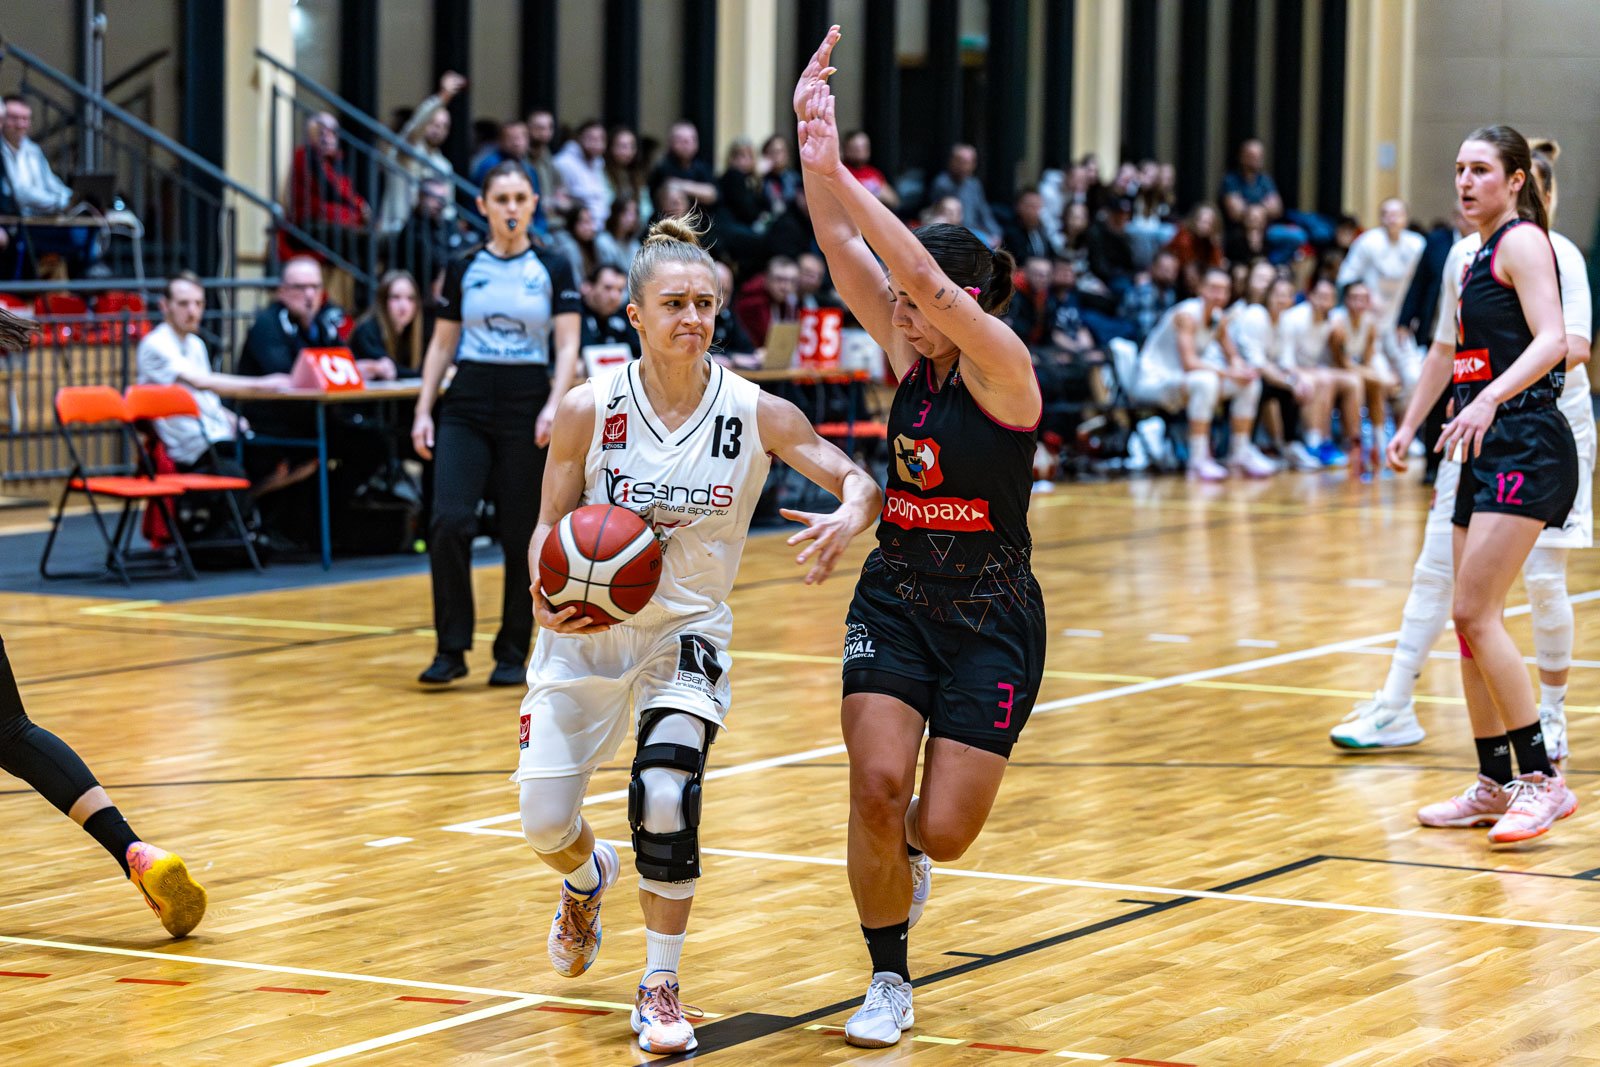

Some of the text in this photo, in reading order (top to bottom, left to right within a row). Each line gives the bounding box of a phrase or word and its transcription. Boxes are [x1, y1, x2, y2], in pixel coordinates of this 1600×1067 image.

[912, 400, 932, 427] 3
[711, 415, 742, 459] 13
[621, 482, 733, 507] iSandS
[1496, 471, 1524, 505] 12
[640, 500, 728, 516] enklawa sportu
[887, 496, 970, 523] pompax
[843, 640, 876, 660] OYAL
[993, 682, 1014, 729] 3
